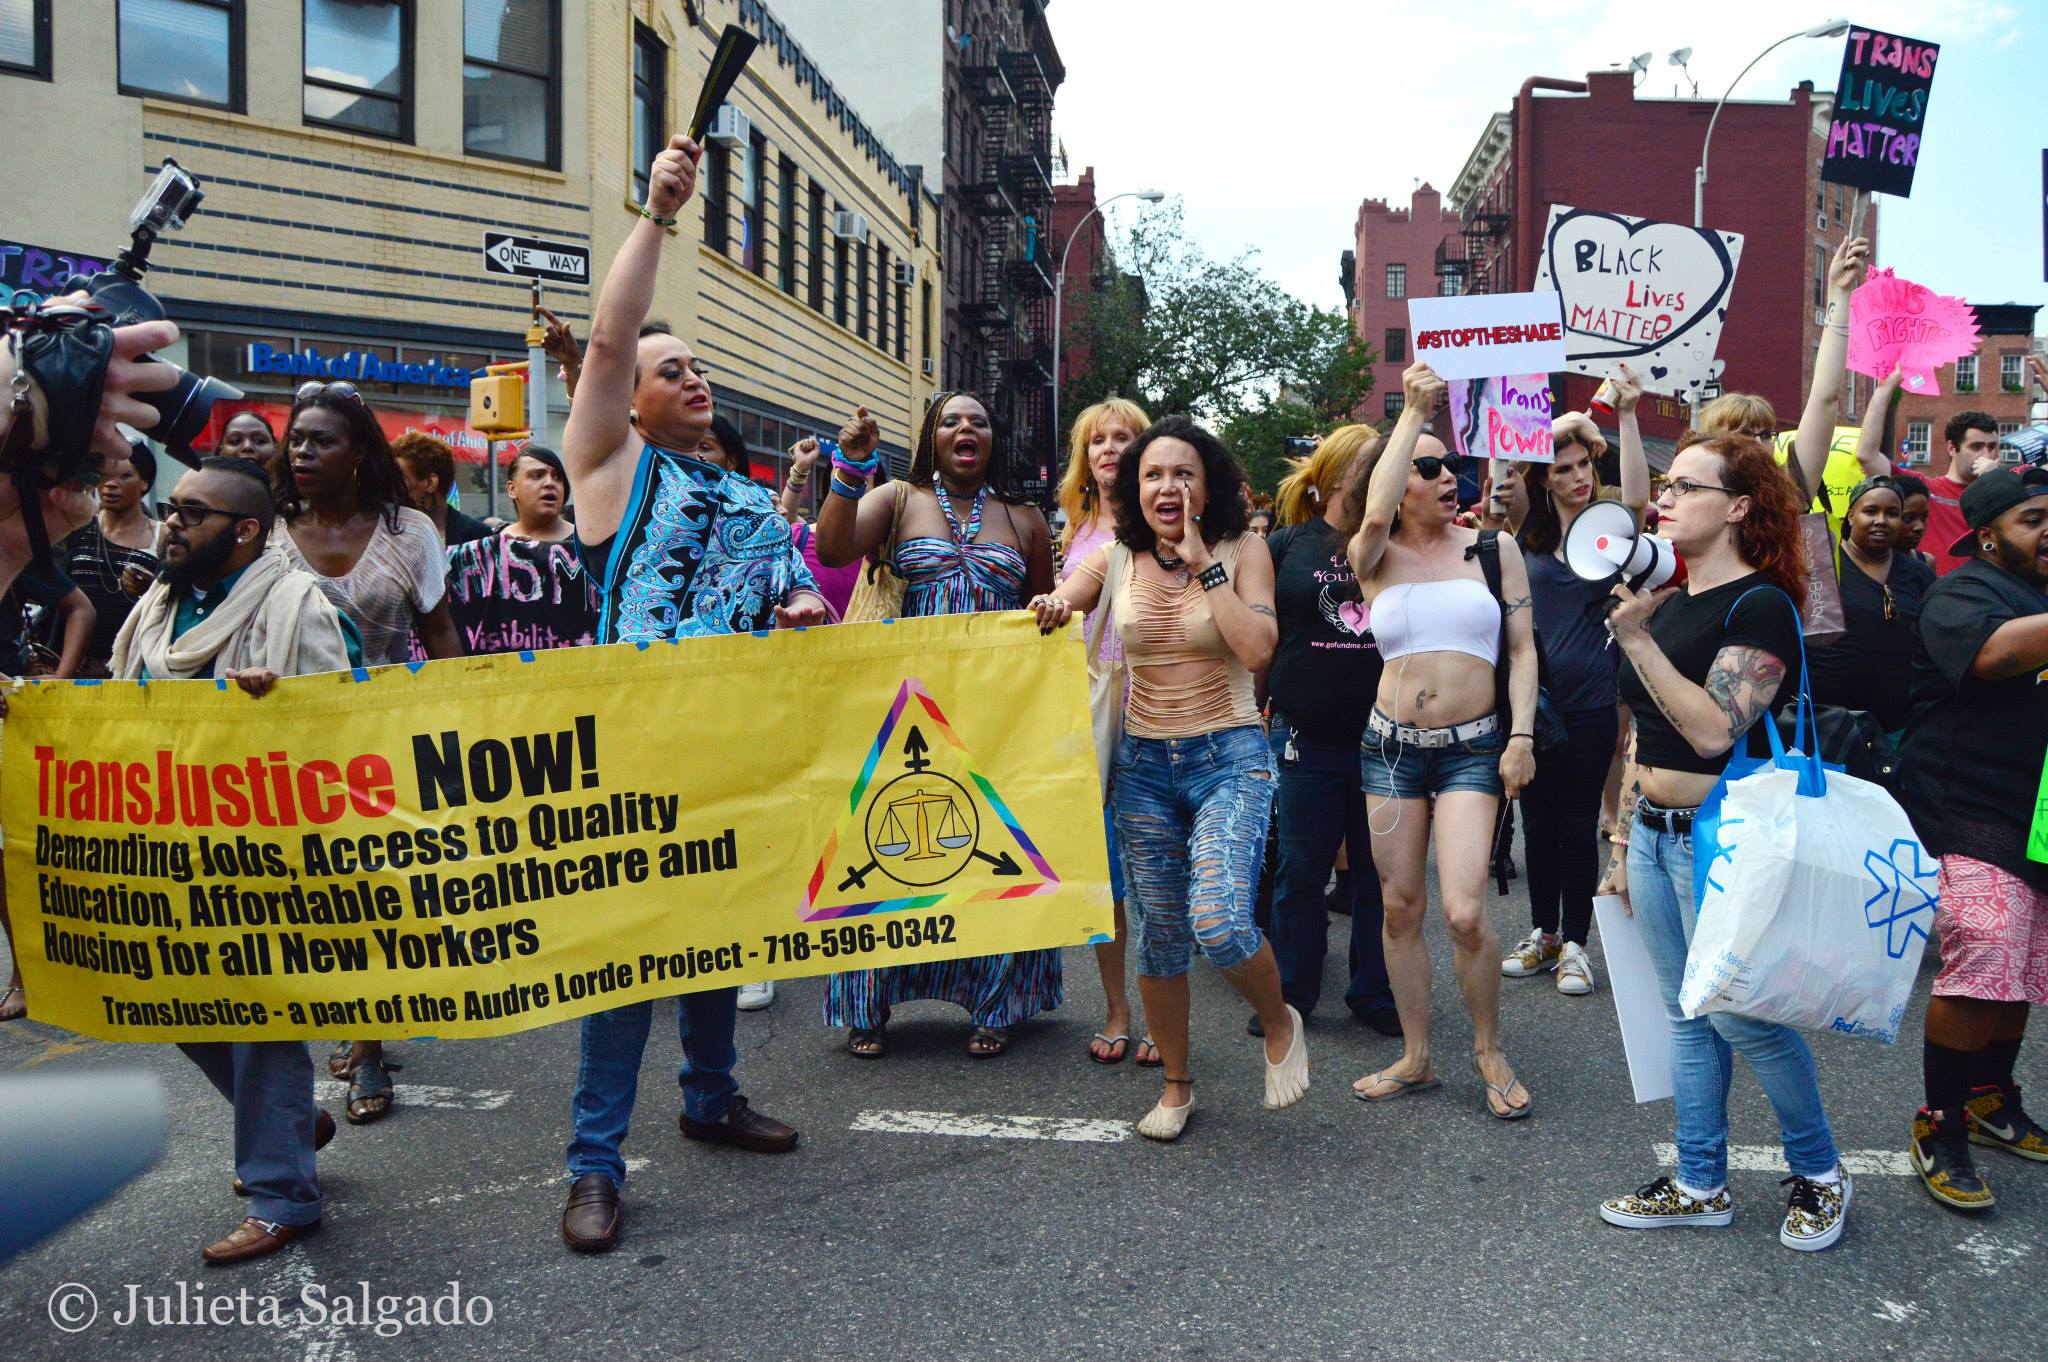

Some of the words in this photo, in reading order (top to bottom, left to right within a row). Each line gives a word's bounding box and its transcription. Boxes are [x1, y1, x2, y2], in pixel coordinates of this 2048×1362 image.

[499, 246, 530, 265] ONE
[548, 253, 581, 272] WAY
[1575, 239, 1664, 274] BLACK
[1417, 322, 1562, 350] #STOPTHESHADE
[1571, 304, 1672, 341] MATTER
[248, 343, 329, 378] Bank
[330, 352, 360, 379] of
[361, 353, 470, 387] America
[34, 745, 395, 827] TransJustice
[412, 715, 600, 811] Now!
[35, 824, 194, 883] Demanding
[198, 835, 298, 881] Jobs,
[303, 823, 469, 877] Access
[476, 815, 518, 856] to
[529, 792, 679, 852] Quality
[38, 874, 182, 932] Education,
[189, 880, 402, 927] Affordable
[410, 847, 649, 918] Healthcare
[658, 829, 738, 879] and
[43, 922, 153, 981] Housing
[157, 935, 210, 976] for
[219, 932, 272, 976] all
[279, 931, 369, 975] New
[373, 918, 540, 970] Yorkers
[102, 995, 268, 1027] TransJustice
[288, 1001, 307, 1025] a
[310, 996, 371, 1027] part
[375, 994, 402, 1023] of
[407, 993, 457, 1023] the
[464, 981, 550, 1022] Audre
[554, 962, 633, 1004] Lorde
[638, 942, 743, 984] Project
[763, 914, 957, 964] 718-596-0342
